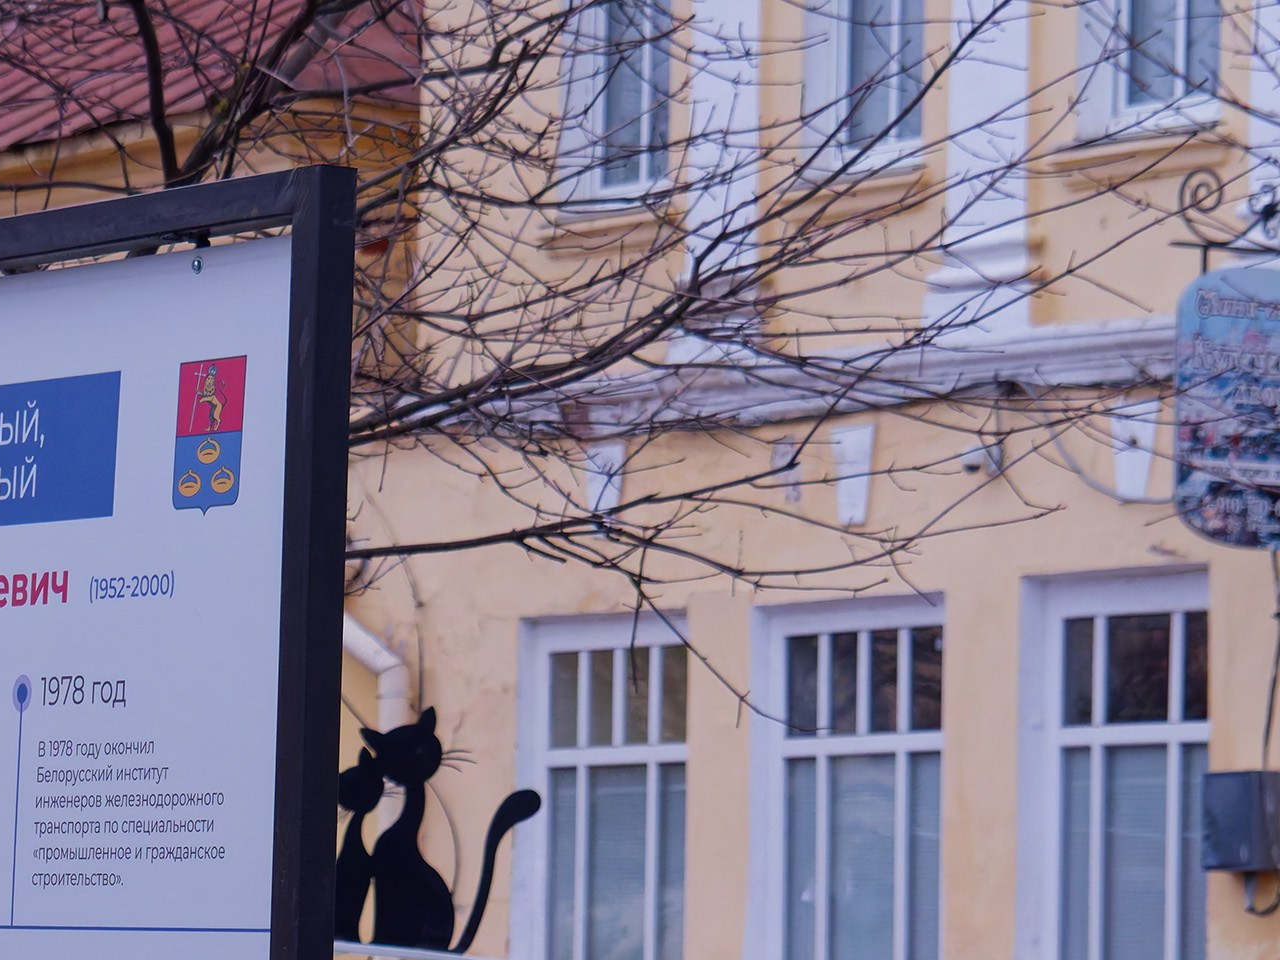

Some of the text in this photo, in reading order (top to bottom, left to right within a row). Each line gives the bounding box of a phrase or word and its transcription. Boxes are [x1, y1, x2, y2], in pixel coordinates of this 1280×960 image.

[89, 570, 175, 604] (1952-2000)
[41, 675, 127, 708] 1978 год
[38, 740, 155, 759] В 1978 году окончил
[36, 764, 169, 786] Белорусский институт
[35, 792, 225, 812] инженеров железнодорожного
[34, 818, 215, 838] транспорта по специальности
[33, 845, 226, 863] «промышленное и гражданское
[32, 872, 124, 890] строительство».
